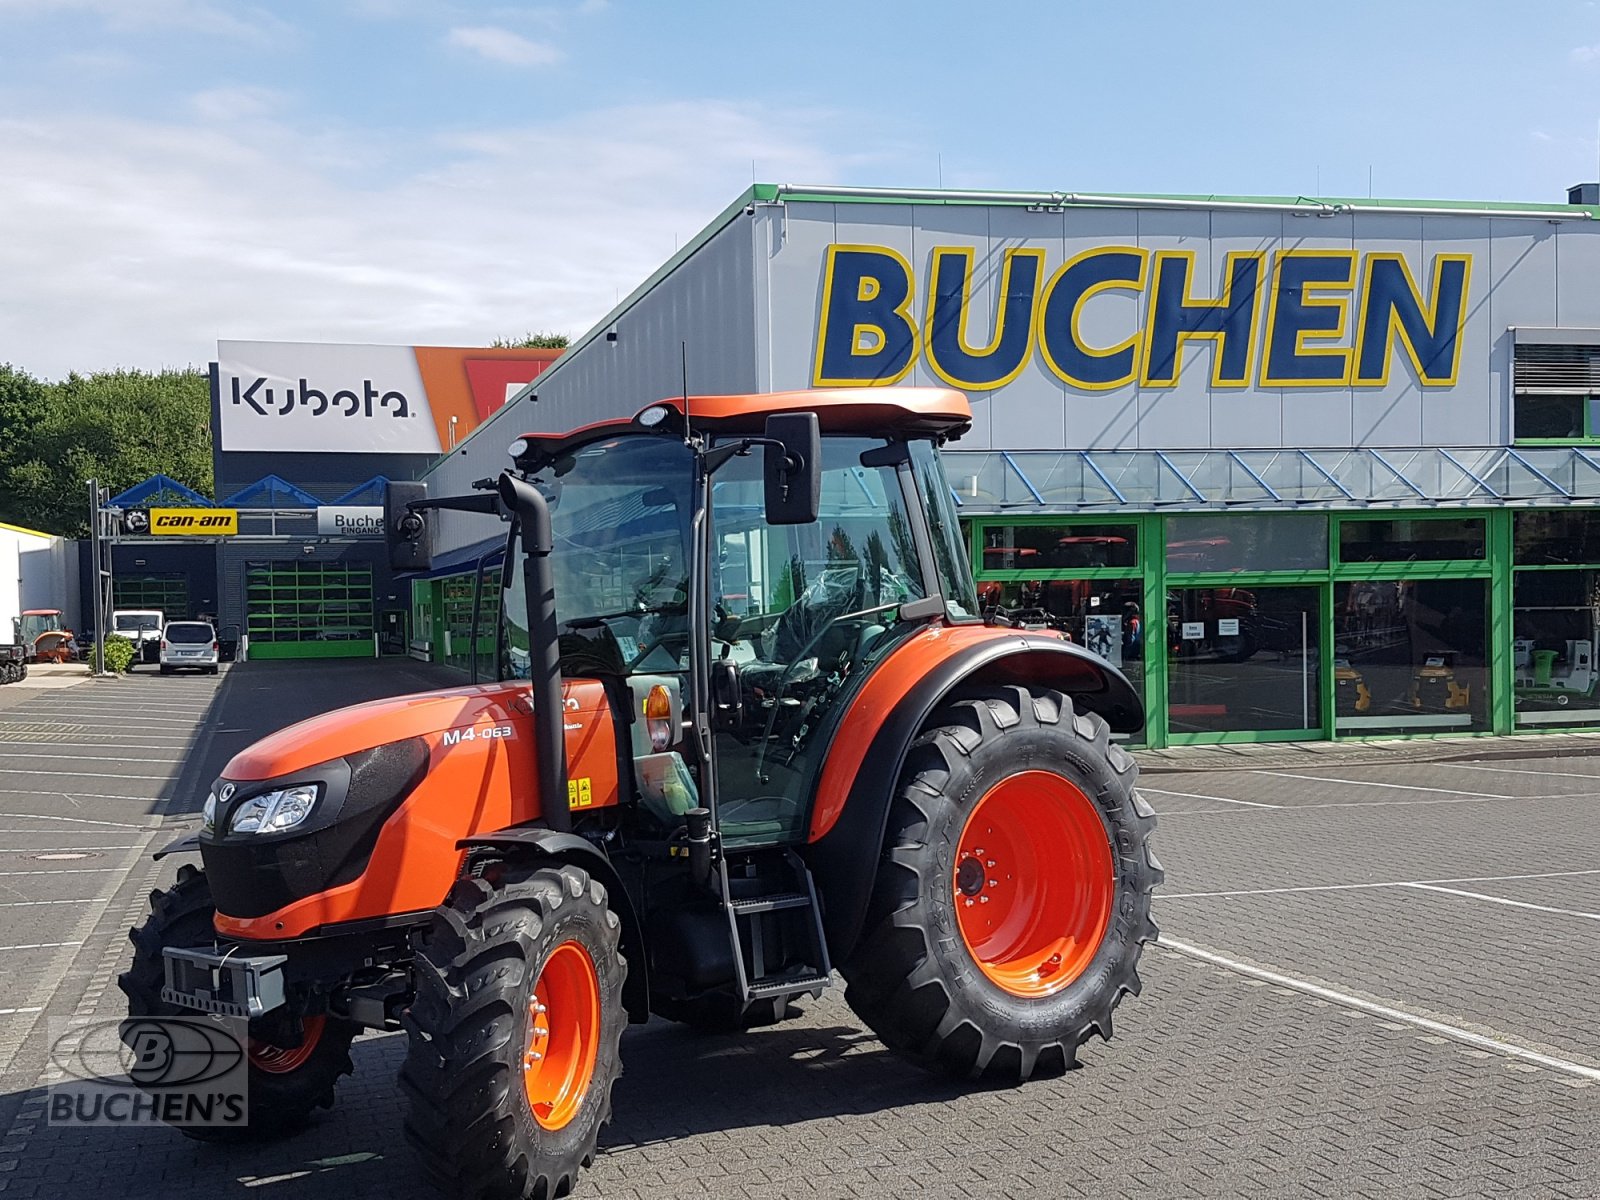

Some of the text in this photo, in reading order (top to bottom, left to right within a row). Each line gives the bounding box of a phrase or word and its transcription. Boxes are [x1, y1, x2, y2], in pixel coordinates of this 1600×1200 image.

[812, 243, 1473, 392] BUCHEN
[231, 376, 409, 418] Kubota
[155, 515, 232, 527] can-am
[443, 726, 512, 746] M4-063
